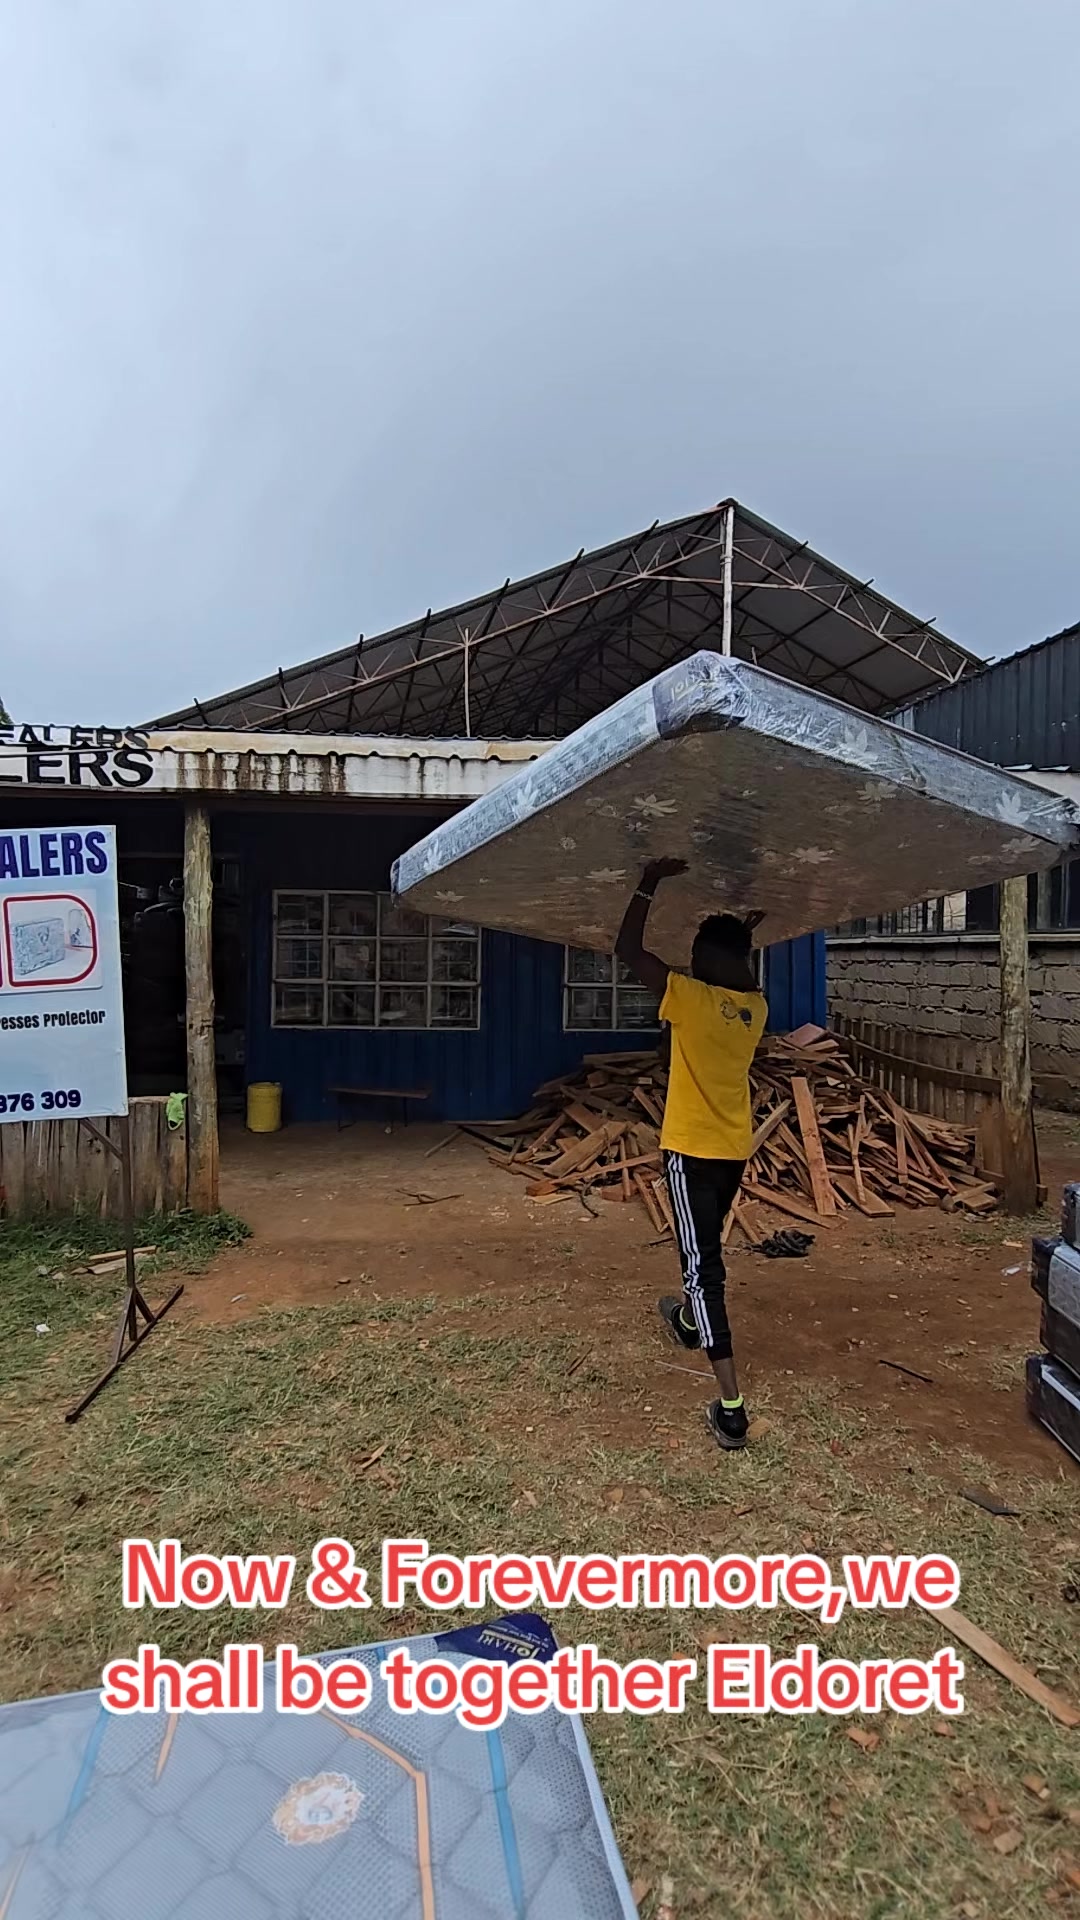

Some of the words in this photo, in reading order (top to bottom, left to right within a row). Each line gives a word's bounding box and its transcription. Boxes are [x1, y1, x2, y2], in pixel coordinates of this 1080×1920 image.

[0, 831, 107, 878] ALERS
[0, 1015, 40, 1030] esses
[43, 1010, 106, 1027] Protector
[41, 1090, 81, 1110] 309
